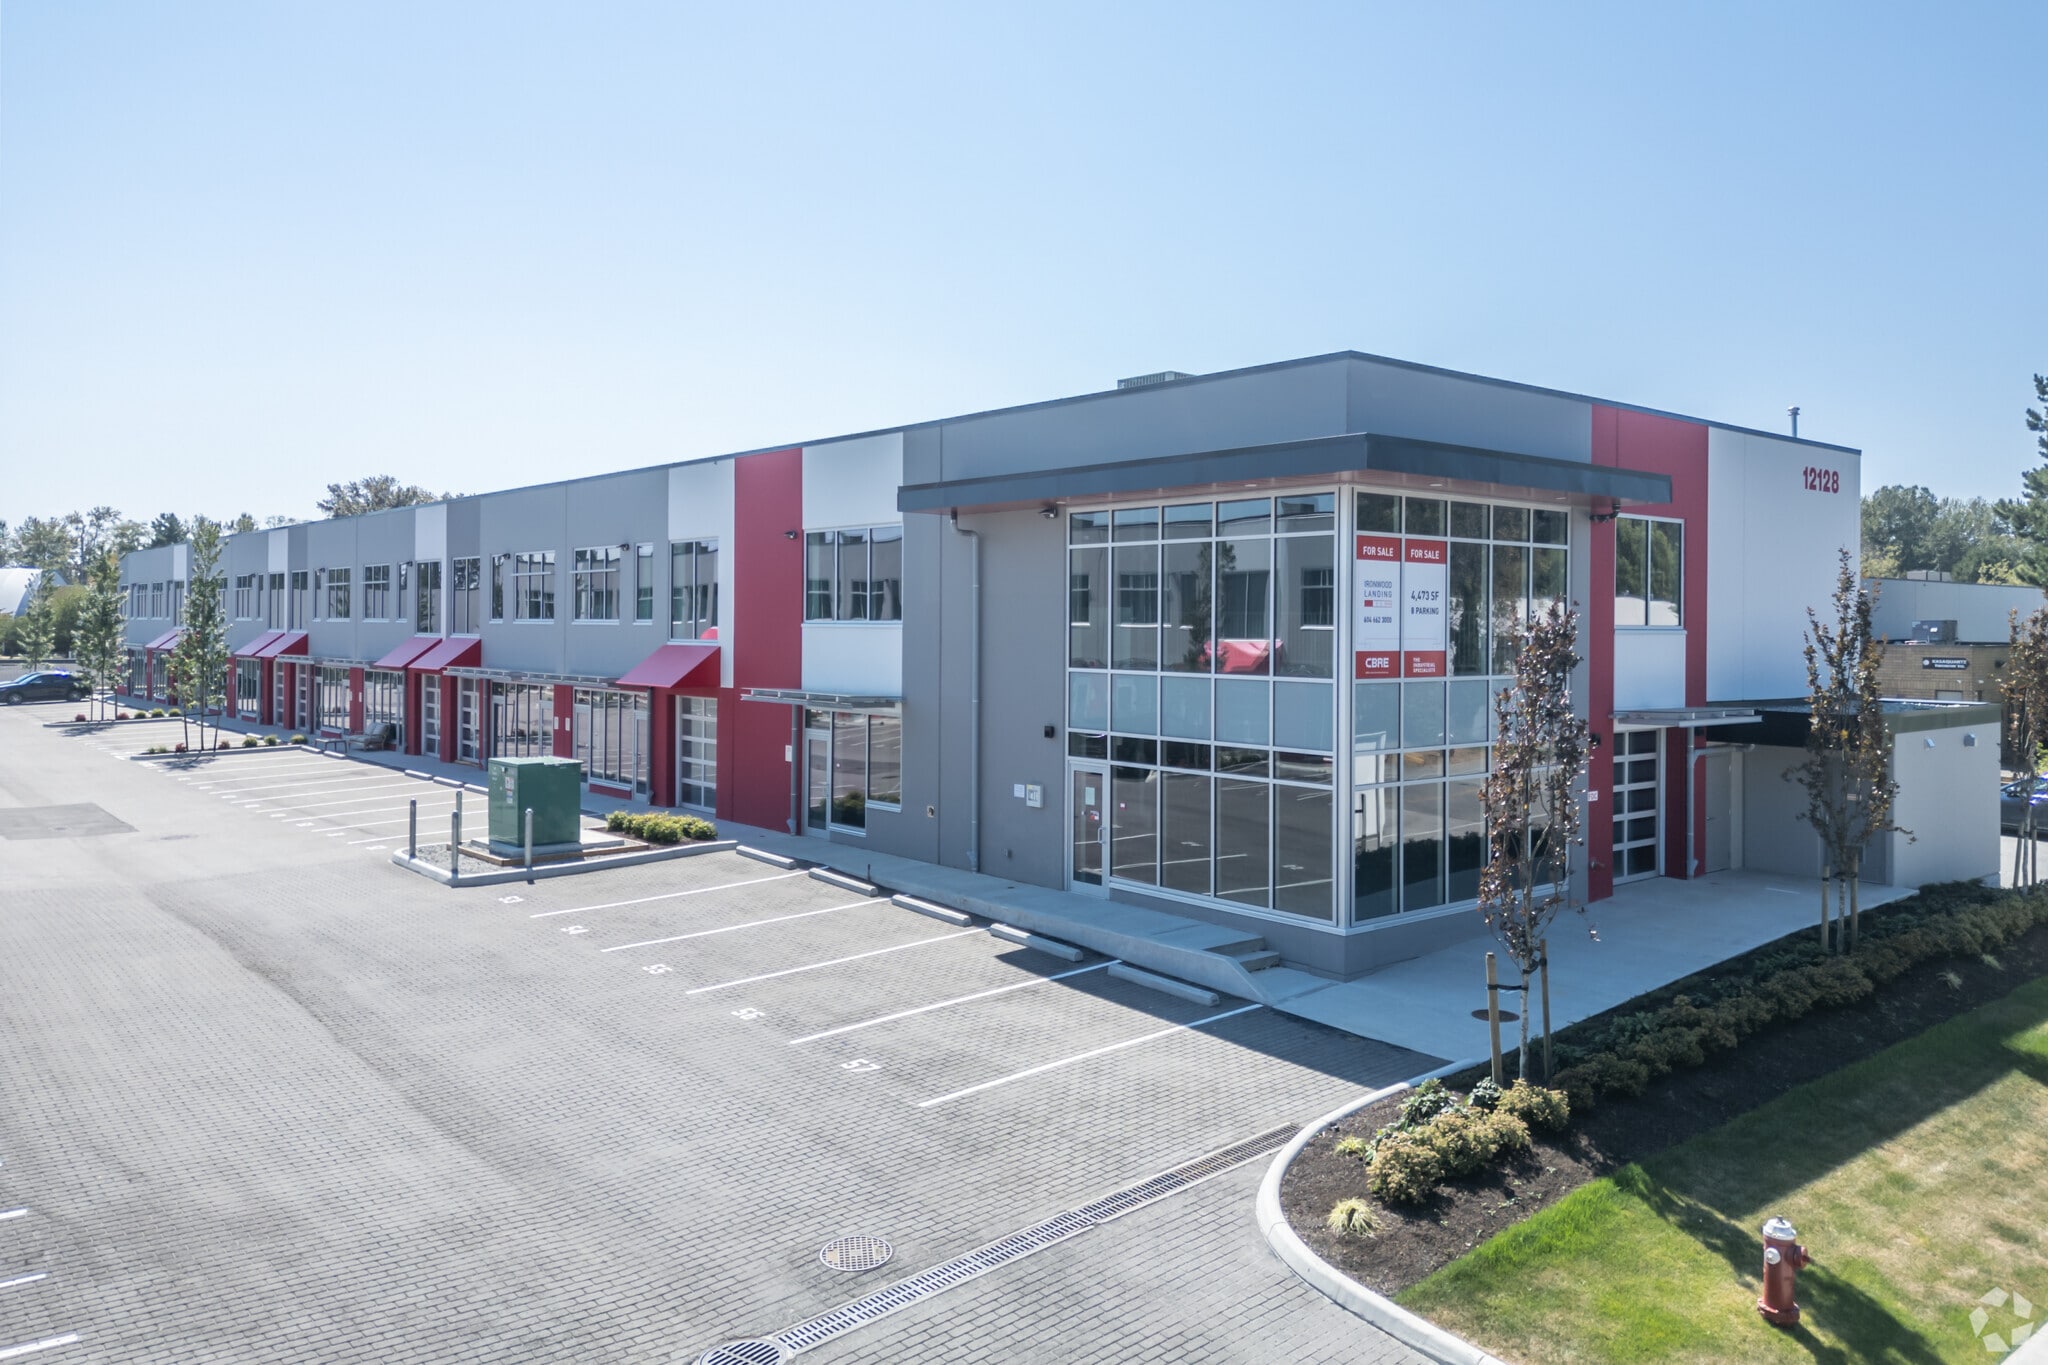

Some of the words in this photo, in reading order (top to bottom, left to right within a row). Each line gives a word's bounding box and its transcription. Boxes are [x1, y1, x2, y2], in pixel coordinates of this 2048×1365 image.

[1803, 466, 1839, 494] 12128
[1363, 546, 1376, 556] FOR
[1377, 547, 1394, 557] SALE
[1411, 549, 1423, 559] FOR
[1424, 550, 1440, 559] SALE
[1364, 580, 1392, 589] IRONWOOD
[1364, 590, 1392, 598] LANDING
[1411, 591, 1430, 602] 4,473
[1431, 591, 1439, 601] SF
[1416, 606, 1439, 615] PARKING
[1365, 658, 1389, 668] CBRE
[839, 1058, 882, 1072] 57
